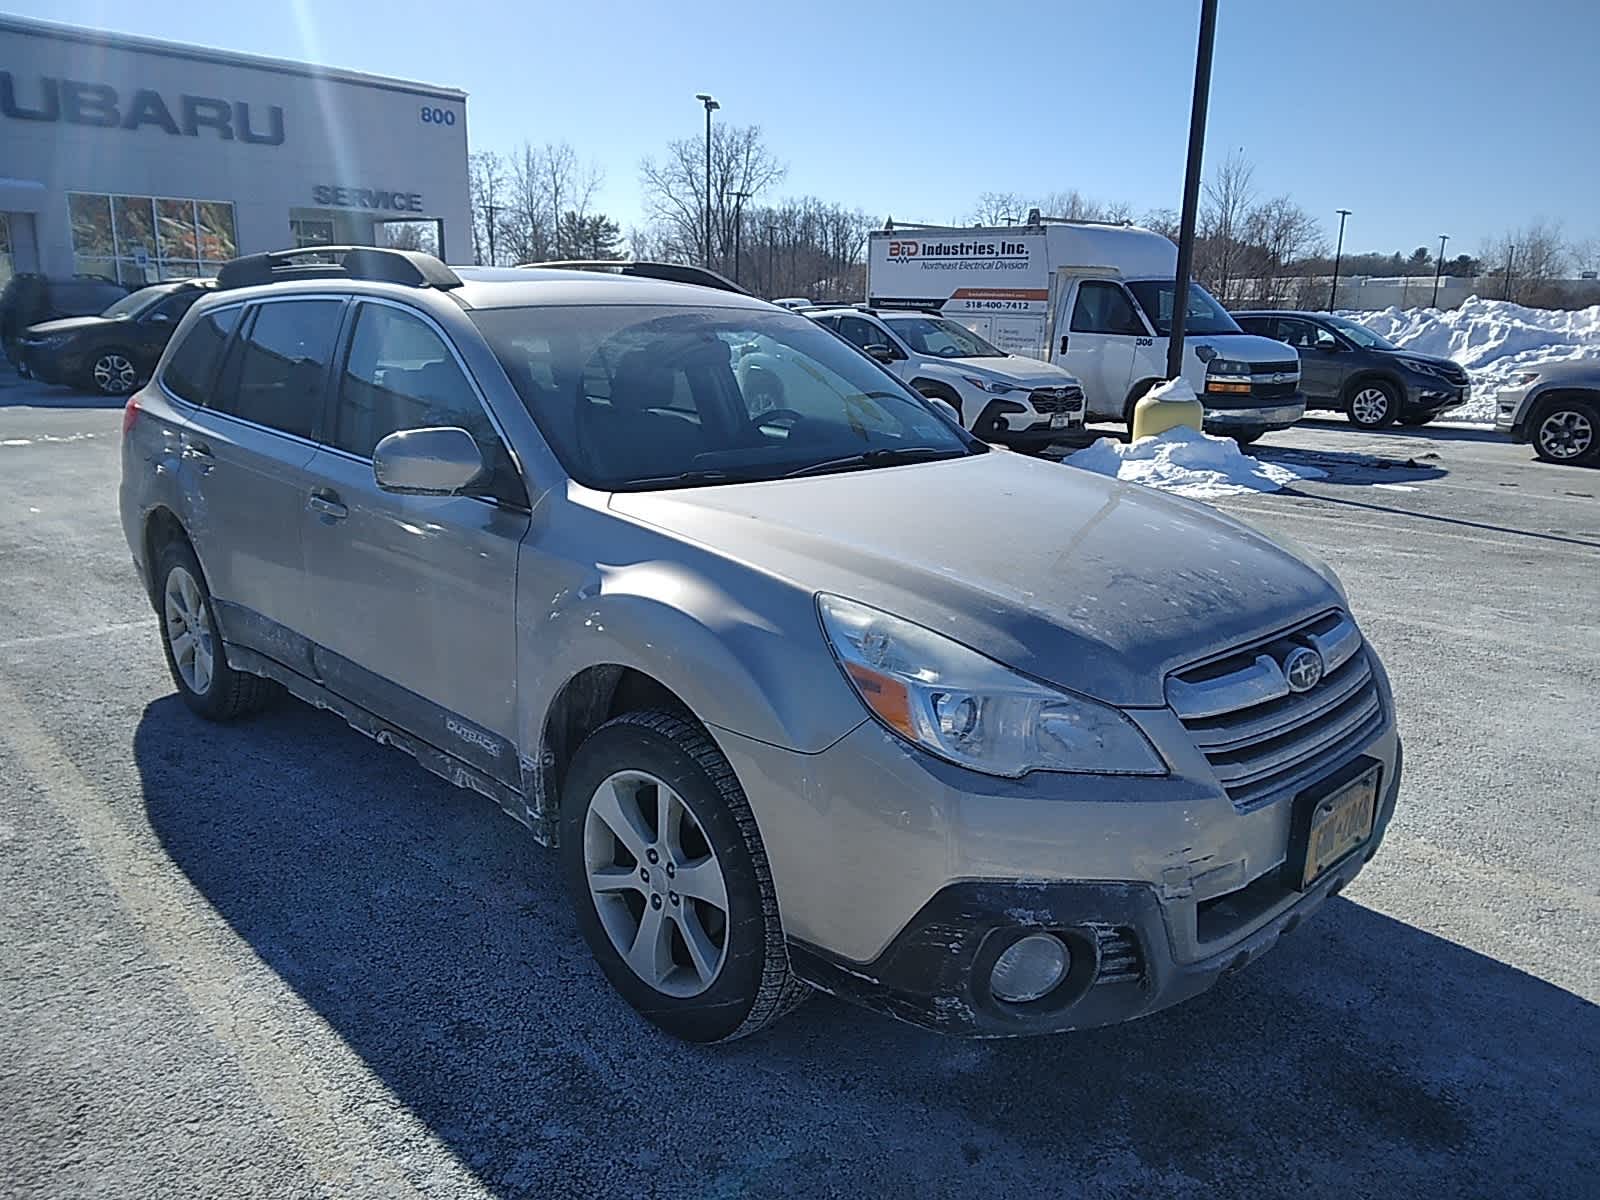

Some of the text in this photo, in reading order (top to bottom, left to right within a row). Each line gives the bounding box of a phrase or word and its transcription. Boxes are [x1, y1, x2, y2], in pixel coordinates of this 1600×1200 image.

[0, 70, 286, 146] UBARU
[421, 106, 455, 126] 800
[312, 185, 424, 213] SERVICE
[1000, 240, 1029, 255] Inc.
[920, 259, 1029, 271] Northeast Electrical Division
[965, 301, 1029, 311] 518-400-7412
